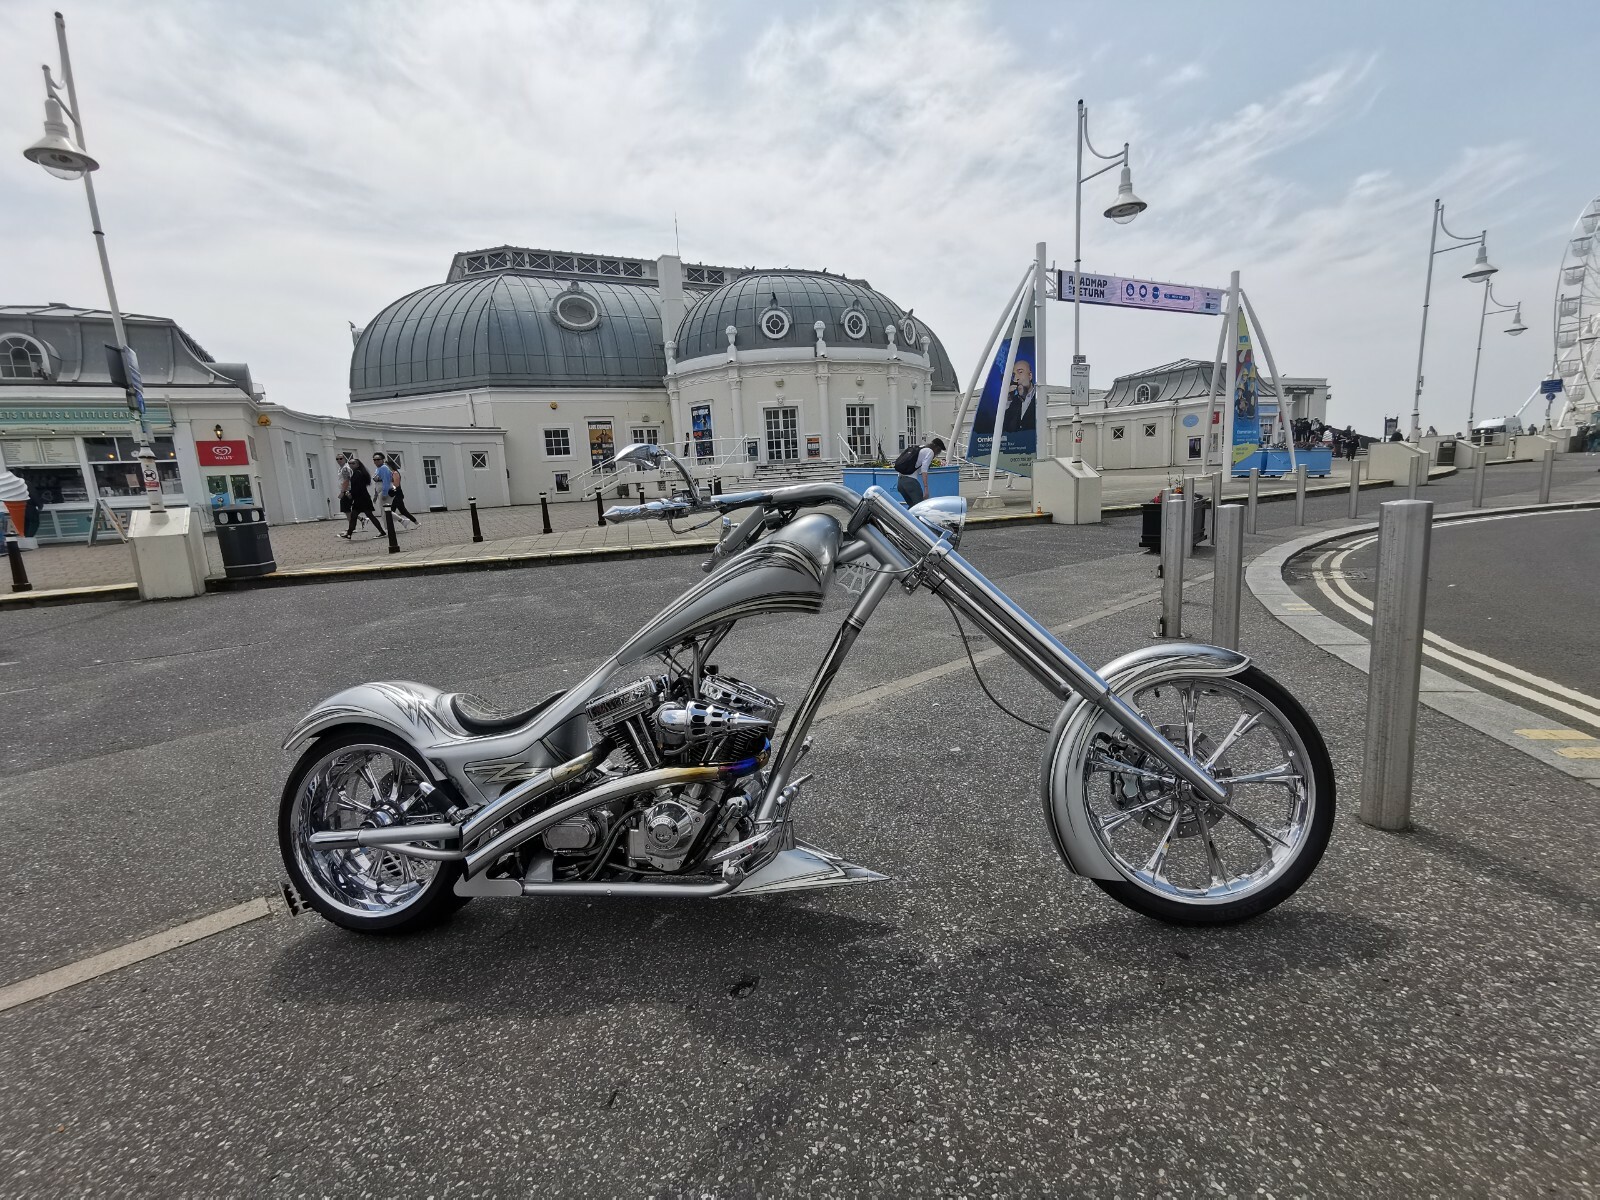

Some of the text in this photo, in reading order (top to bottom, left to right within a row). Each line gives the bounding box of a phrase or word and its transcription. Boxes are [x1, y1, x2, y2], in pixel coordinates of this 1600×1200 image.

[1068, 275, 1108, 288] RADMAP
[21, 411, 61, 420] TREATS
[64, 411, 71, 420] &
[74, 411, 109, 420] LITTLE
